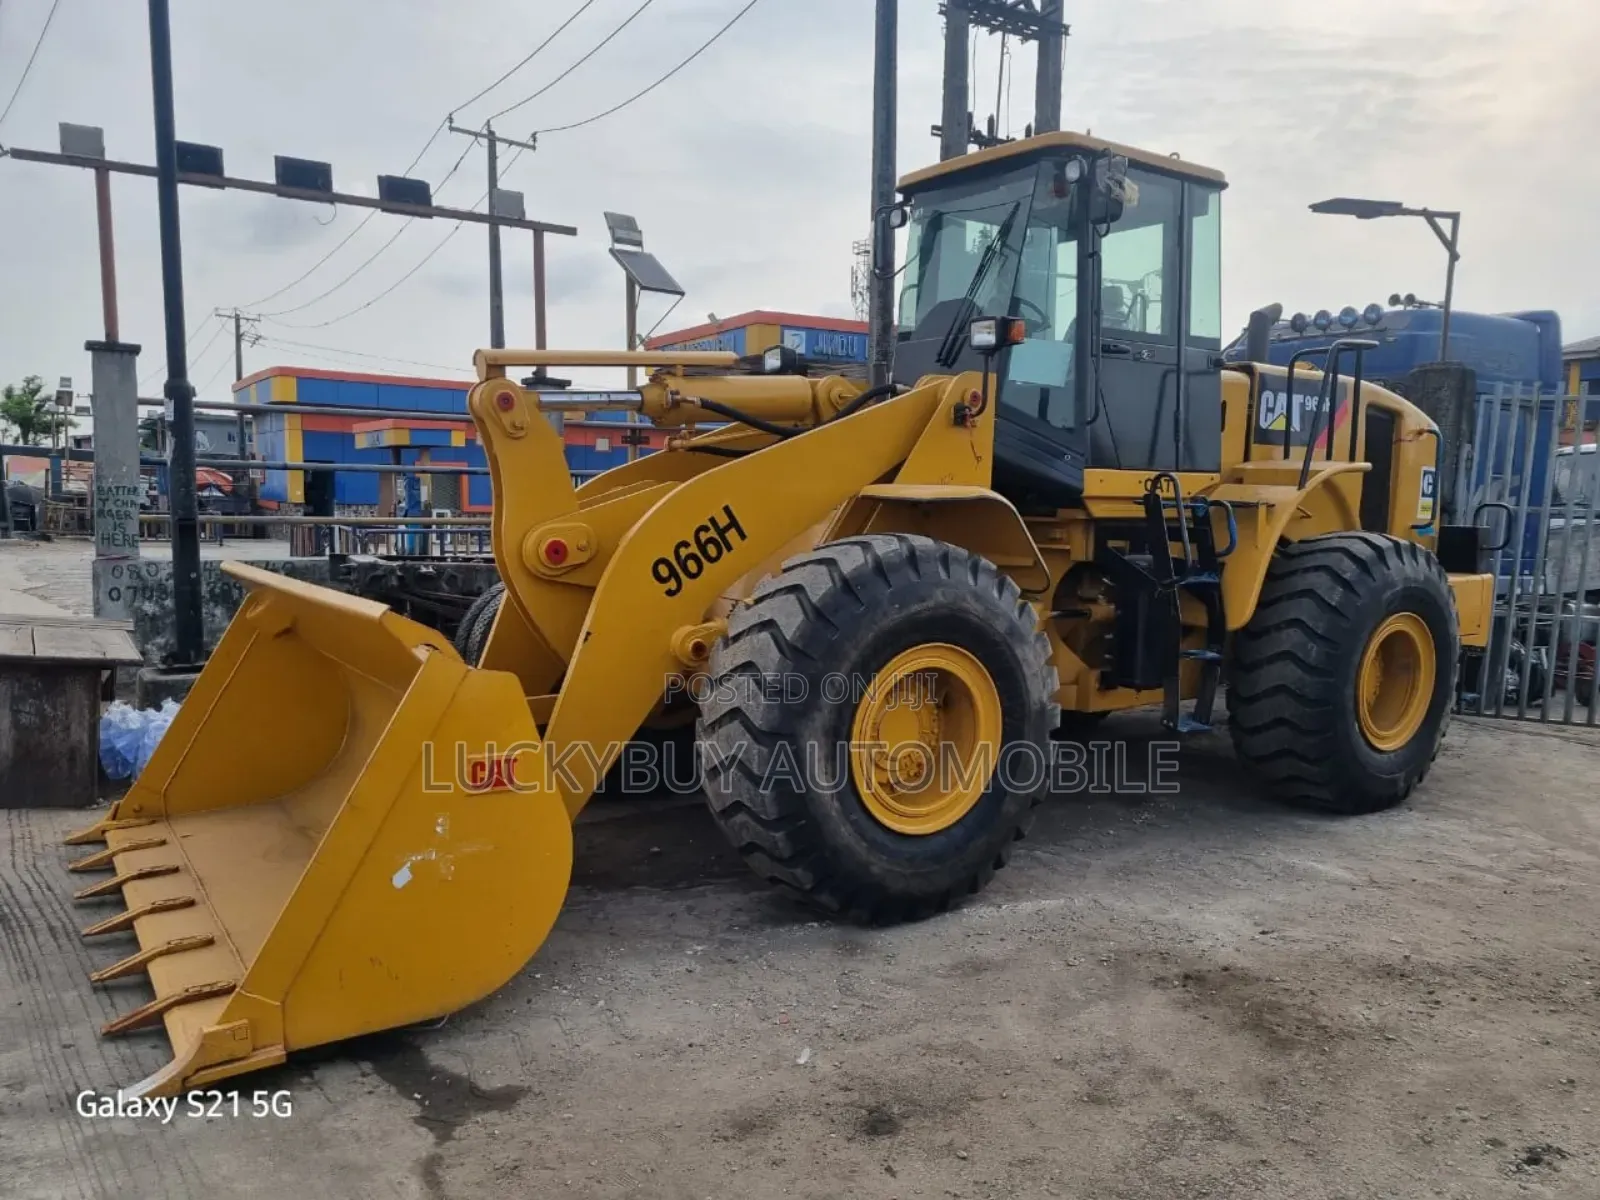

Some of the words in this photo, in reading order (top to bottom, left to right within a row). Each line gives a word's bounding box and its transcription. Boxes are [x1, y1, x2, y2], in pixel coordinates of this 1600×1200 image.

[1260, 390, 1304, 432] CAT
[101, 532, 140, 548] HERE
[113, 521, 126, 533] IS
[652, 504, 747, 597] 966H
[471, 757, 517, 789] CAT
